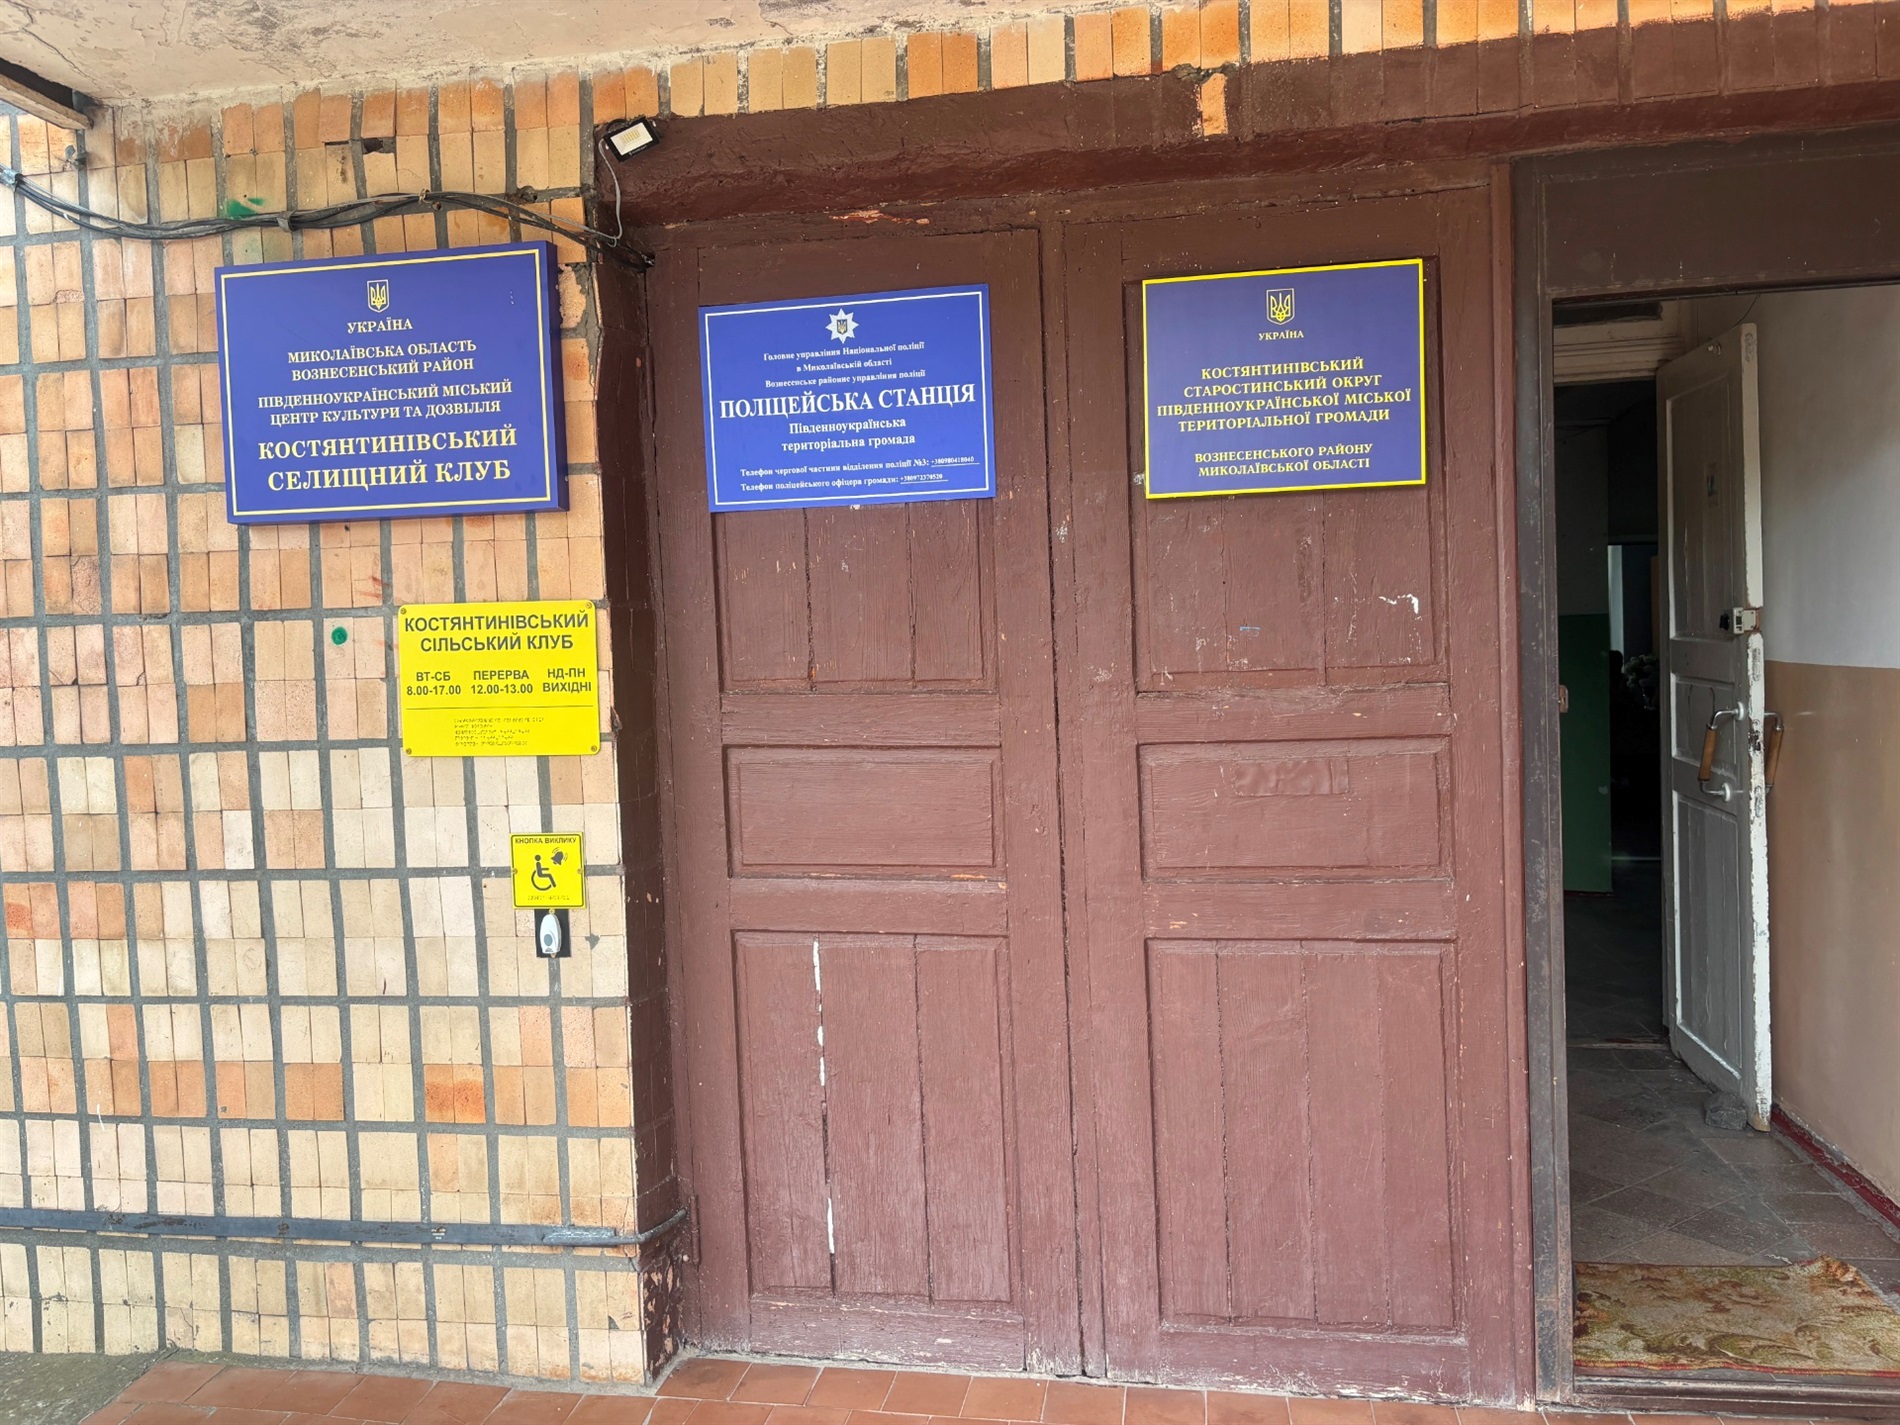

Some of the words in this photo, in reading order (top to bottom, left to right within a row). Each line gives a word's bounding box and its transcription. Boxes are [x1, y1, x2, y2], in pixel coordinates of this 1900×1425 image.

[347, 318, 413, 334] УКРАЇНА
[1258, 330, 1304, 341] УКРАЇНА
[288, 345, 404, 364] МИКОЛАЇВСЬКА
[408, 340, 477, 355] ОБЛАСТЬ
[763, 353, 795, 361] Головне
[796, 349, 841, 361] управління
[842, 344, 896, 355] Національної
[897, 342, 925, 351] поліції
[292, 362, 419, 381] ВОЗНЕСЕНСЬКИЙ
[423, 358, 474, 373] РАЙОН
[803, 361, 862, 372] Миколаївській
[863, 358, 892, 367] області
[1201, 356, 1364, 379] КОСТЯНТИНІВСЬКИЙ
[765, 379, 817, 388] Вознесенське
[818, 376, 851, 386] районне
[852, 373, 897, 383] управління
[898, 370, 926, 379] поліції
[1183, 377, 1327, 397] СТАРОСТИНСЬКИЙ
[1332, 374, 1382, 387] ОКРУГ
[258, 384, 439, 409] ПІВДЕННОУКРАЇНСЬКИЙ
[443, 379, 512, 395] МІСЬКИЙ
[719, 390, 873, 419] ПОЛІЦЕЙСЬКА
[878, 383, 976, 409] СТАНЦІЯ
[1157, 393, 1339, 417] ПІВДЕННОУКРАЇНСЬКОЇ
[1344, 388, 1411, 405] МІСЬКОЇ
[270, 411, 319, 427] ЦЕНТР
[322, 406, 400, 423] КУЛЬТУРИ
[404, 406, 423, 418] ТА
[426, 401, 501, 419] ДОЗВІЛЛЯ
[1178, 413, 1311, 432] ТЕРИТОРІАЛЬНОЇ
[1315, 409, 1390, 424] ГРОМАДИ
[789, 417, 906, 436] Південноукраїнська
[258, 424, 517, 460] КОСТЯНТИНІВСЬКИЙ
[781, 435, 865, 453] територіальна
[868, 434, 915, 448] громада
[1194, 448, 1314, 463] ВОЗНЕСЕНСЬКОГО
[1318, 444, 1373, 455] РАЙОНУ
[267, 459, 429, 491] СЕЛИЩНИЙ
[435, 460, 511, 482] КЛУБ
[740, 468, 773, 477] Телефон
[775, 466, 807, 476] чергової
[843, 460, 884, 471] відділення
[885, 459, 911, 469] поліції
[1198, 460, 1309, 477] МИКОЛАЇВСЬКОЇ
[1313, 458, 1370, 471] ОБЛАСТІ
[740, 483, 773, 492] Телефон
[775, 481, 830, 489] поліцейського
[832, 477, 862, 488] офіцера
[405, 610, 588, 631] КОСТЯНТИНІВСЬКИЙ
[421, 632, 521, 652] СІЛЬСЬКИЙ
[527, 635, 573, 649] КЛУБ
[416, 671, 451, 681] ВТ-СБ
[473, 670, 529, 680] ПЕРЕРВА
[548, 668, 586, 679] НД-ПН
[407, 685, 461, 695] 8.00-17.00
[471, 684, 533, 694] 12.00-13.00
[542, 682, 591, 694] ВИХІДНІ
